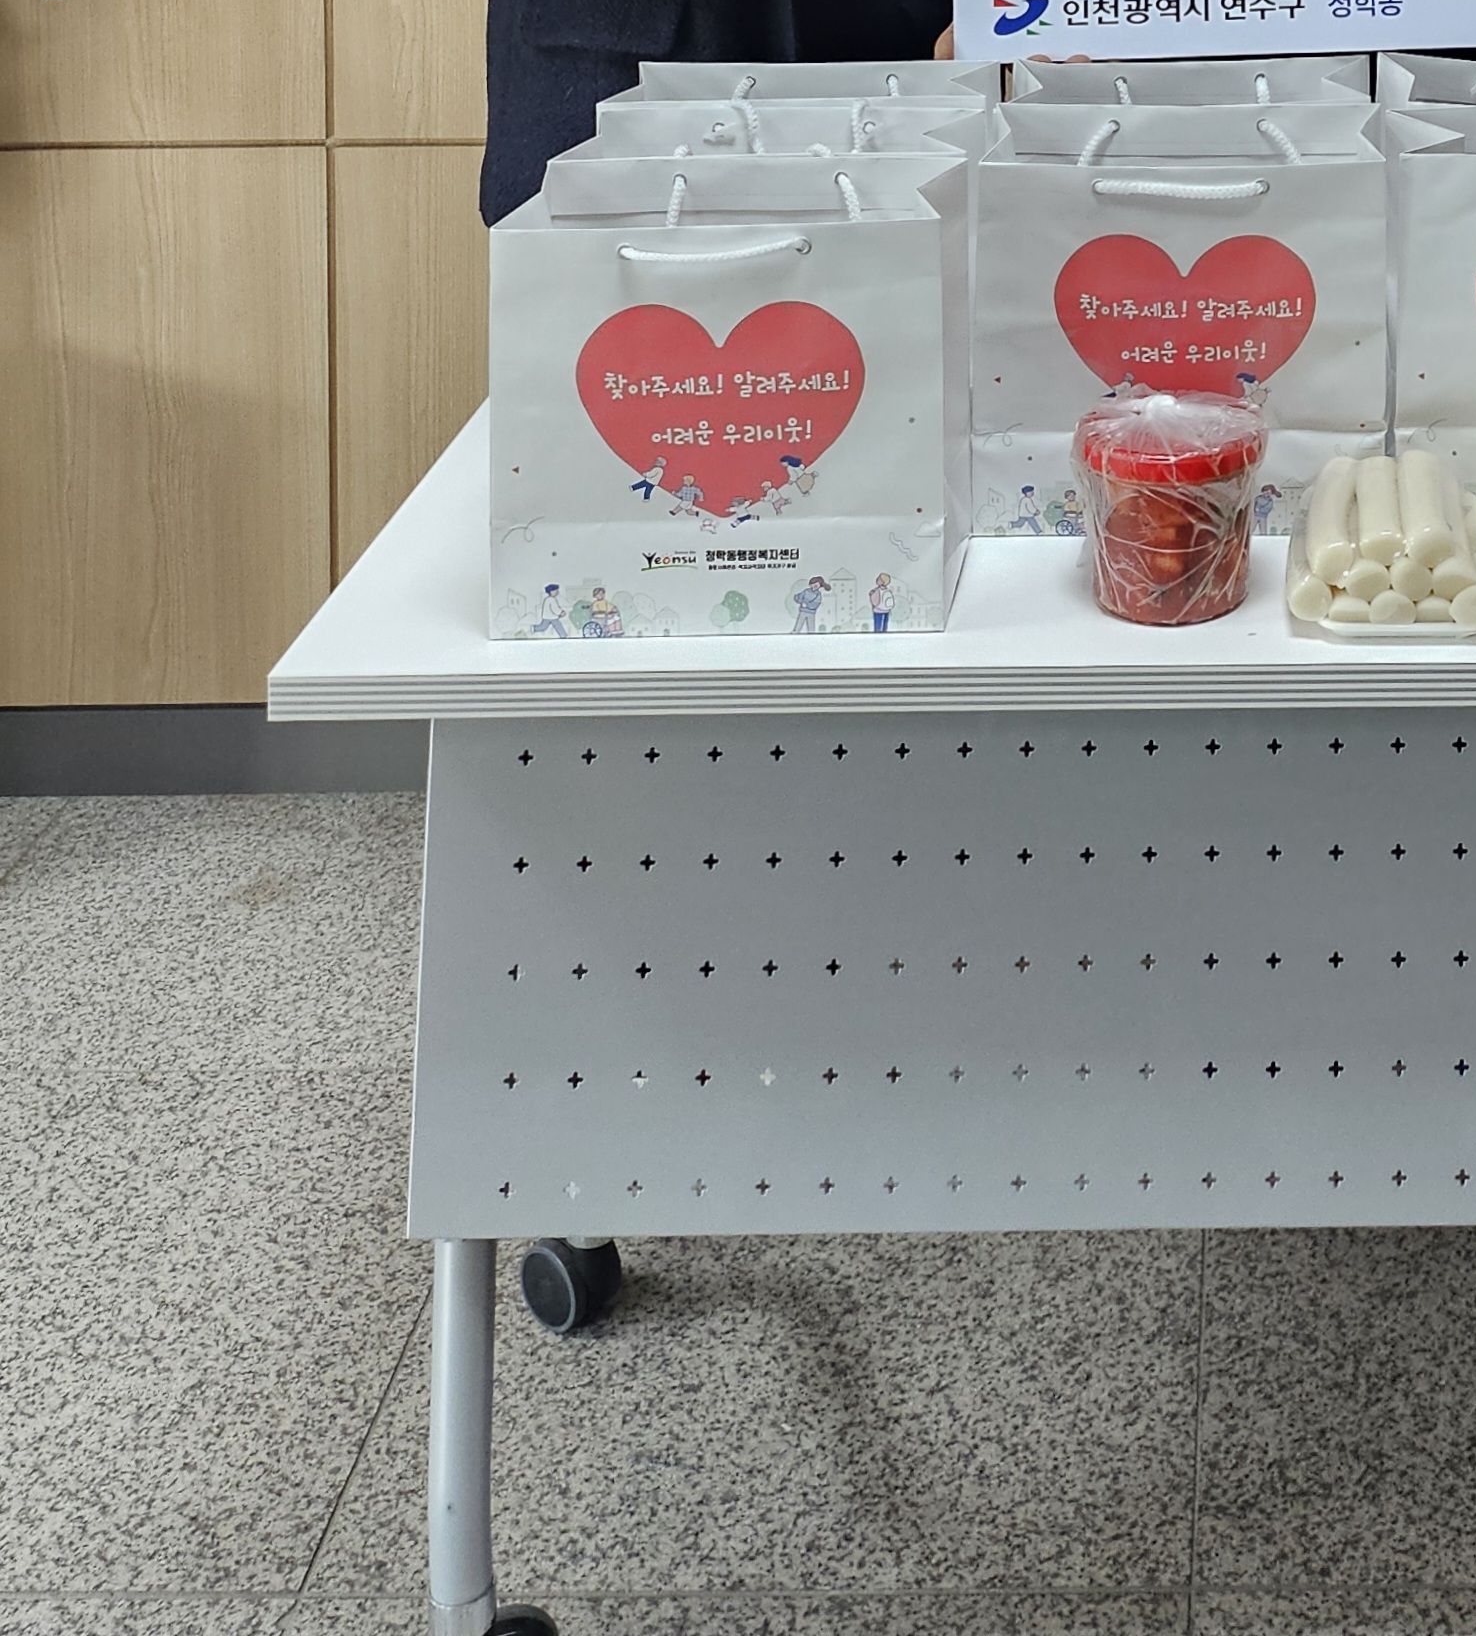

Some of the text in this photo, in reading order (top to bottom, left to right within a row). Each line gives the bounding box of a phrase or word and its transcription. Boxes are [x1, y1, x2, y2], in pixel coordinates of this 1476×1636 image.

[1080, 294, 1301, 321] 찾아주세요! 알려주세요!
[1121, 340, 1266, 363] 어려운 우리이웃!
[604, 370, 850, 399] 찾아주세요! 알려주세요!
[652, 418, 812, 445] 어려운 우리이웃!
